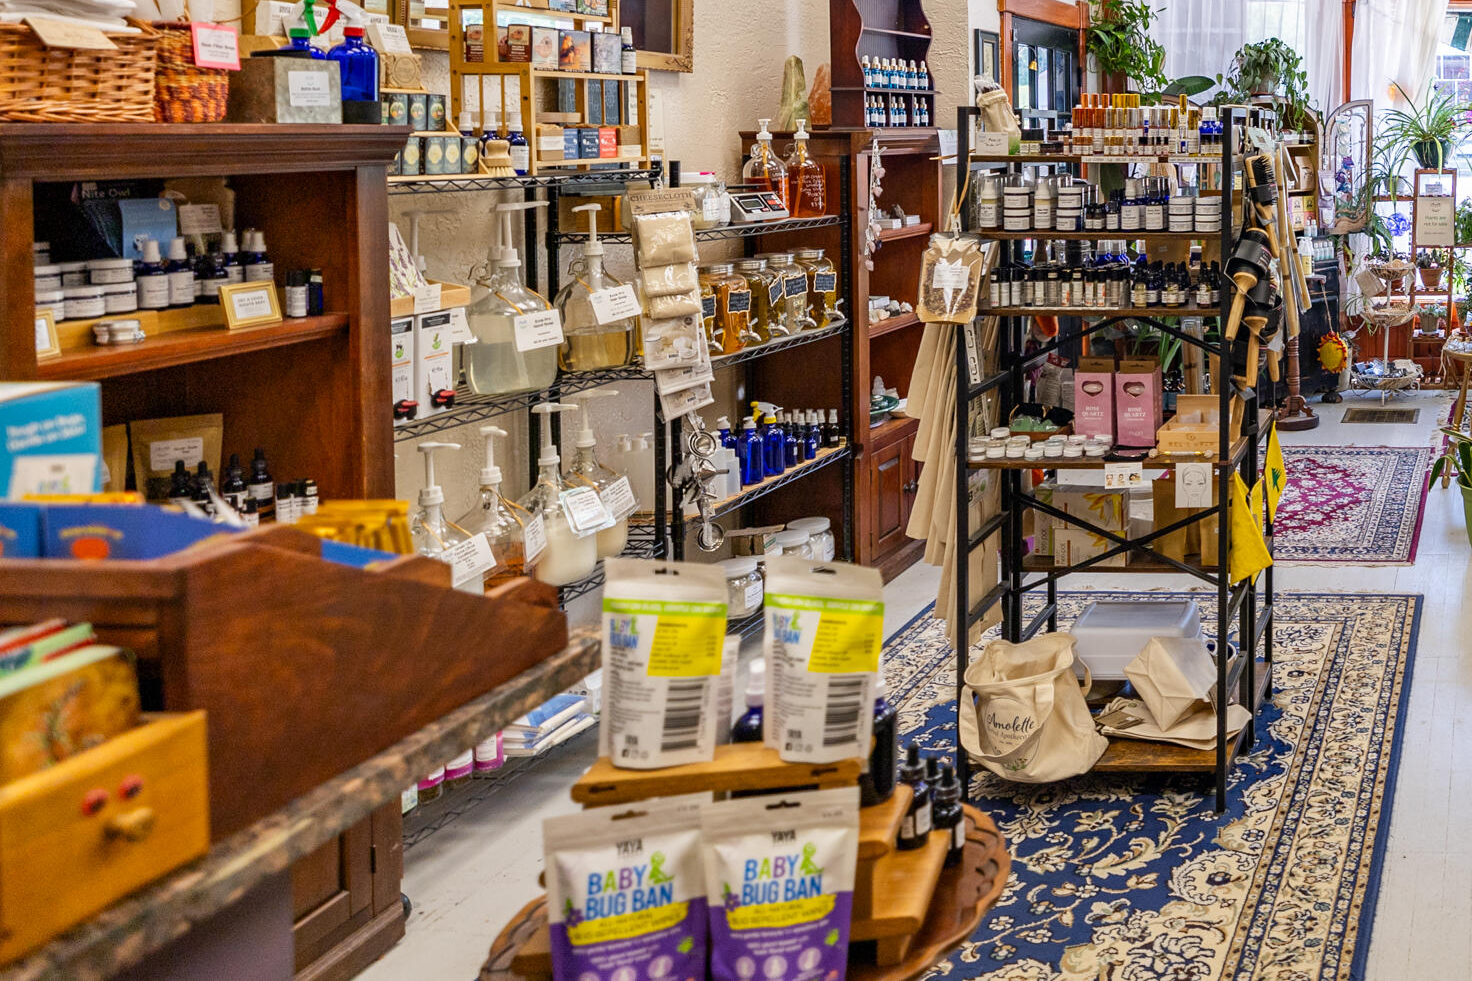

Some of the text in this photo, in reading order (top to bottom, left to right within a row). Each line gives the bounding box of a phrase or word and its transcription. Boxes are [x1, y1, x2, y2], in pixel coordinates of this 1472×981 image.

[630, 192, 692, 202] CHEESECLOTH
[986, 712, 1035, 732] Amolette
[616, 838, 643, 855] YAYA
[771, 830, 796, 843] YAYA
[588, 864, 648, 896] BABY
[744, 854, 800, 882] BABY
[584, 882, 673, 921] BUG BAN
[741, 874, 822, 906] BUG BAN
